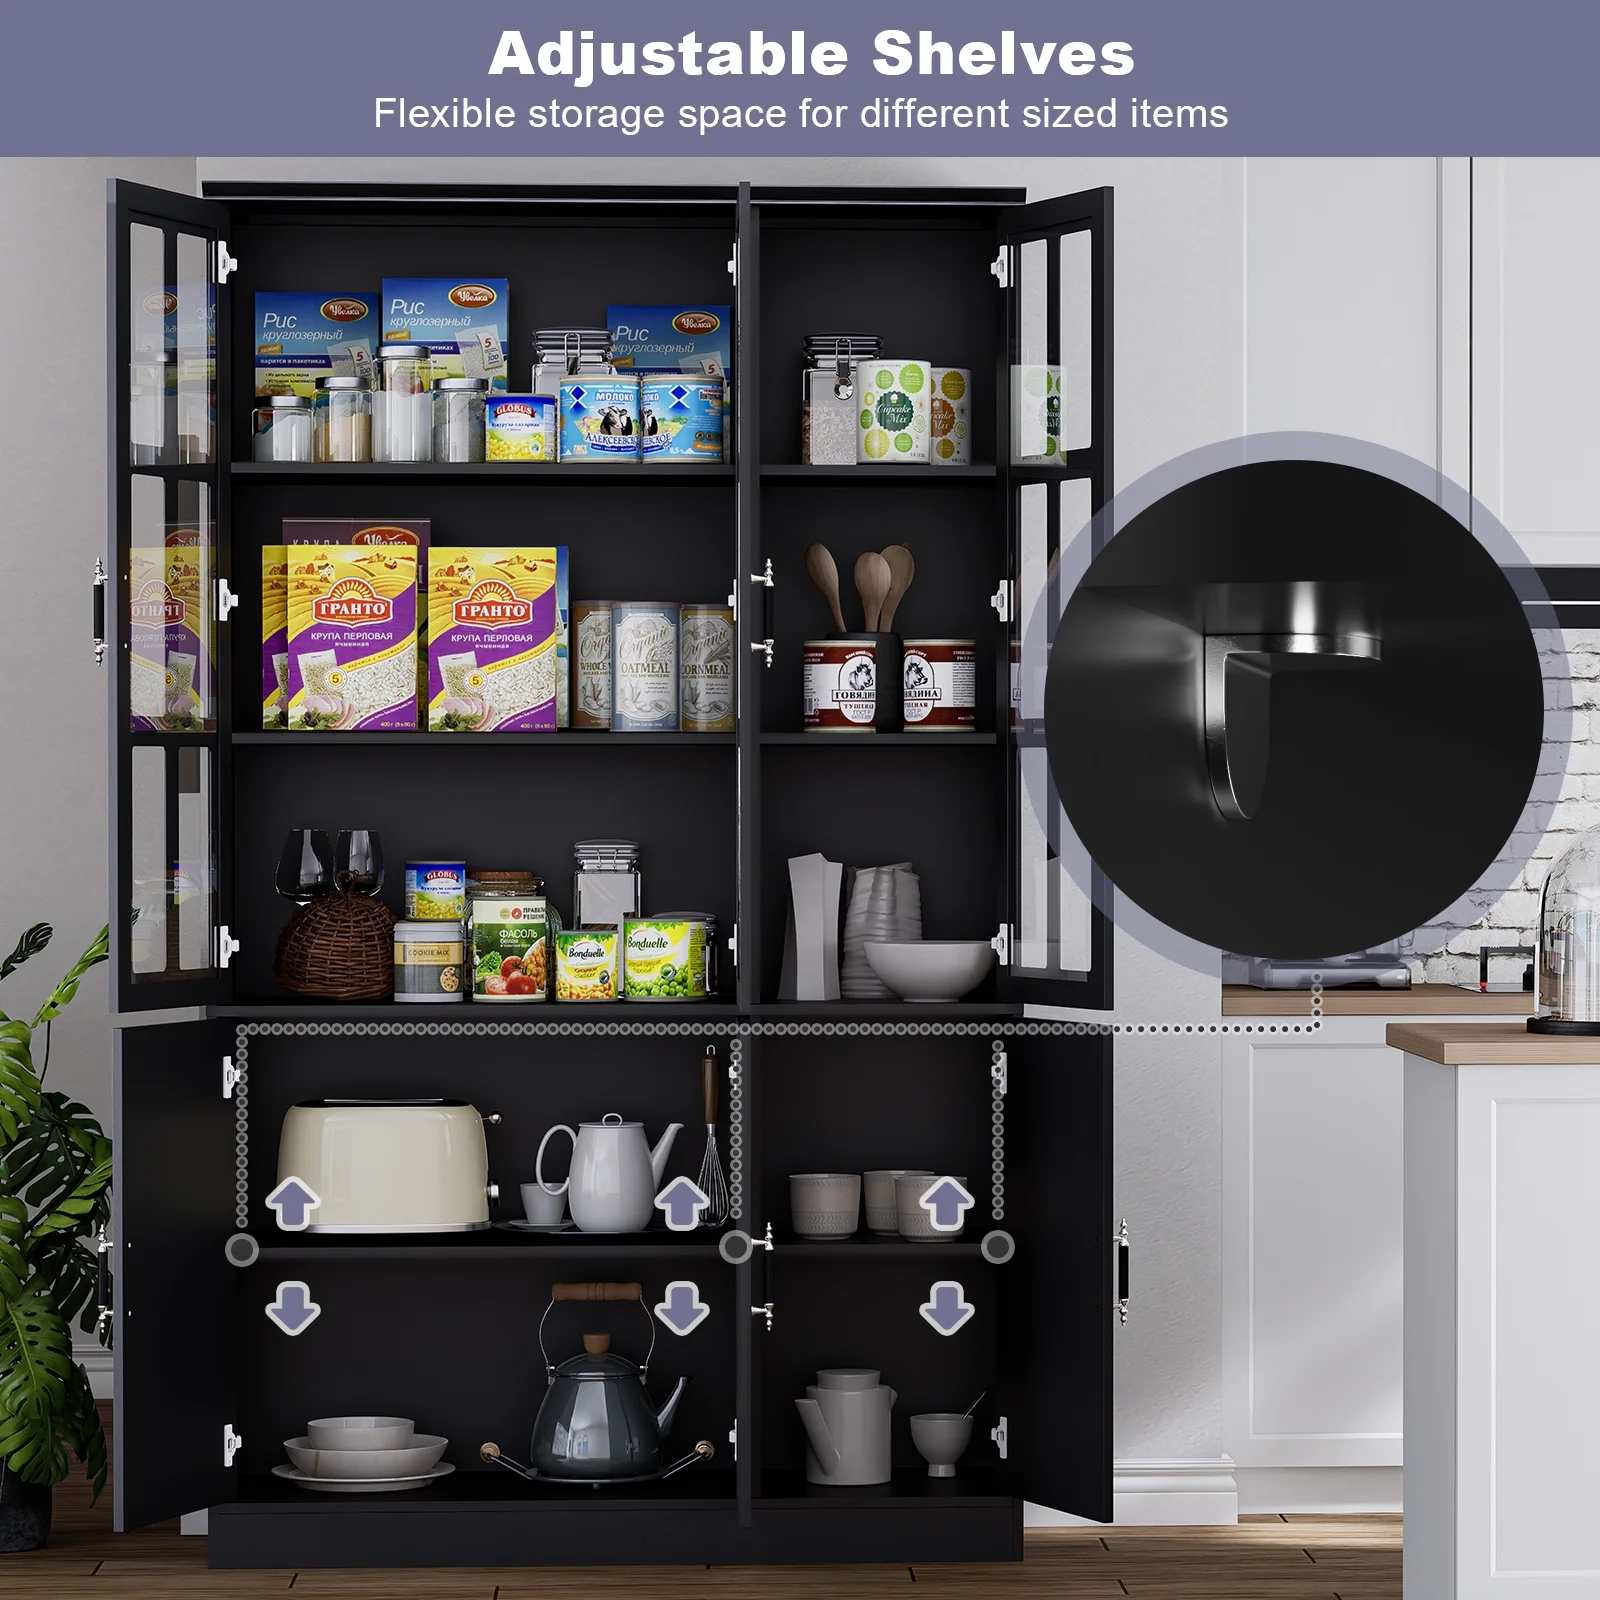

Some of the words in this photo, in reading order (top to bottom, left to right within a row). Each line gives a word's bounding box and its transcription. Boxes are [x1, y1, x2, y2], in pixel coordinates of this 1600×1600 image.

[457, 290, 489, 303] Увелка
[329, 304, 360, 316] Увелка
[390, 298, 425, 315] Рис
[263, 312, 298, 329] Рис
[390, 315, 471, 329] круглозерный
[681, 317, 712, 329] Увелка
[263, 329, 344, 342] круглозерный
[616, 325, 649, 341] Рис
[484, 337, 492, 348] 5
[356, 351, 364, 361] 5
[707, 364, 716, 375] 5
[596, 392, 634, 402] МОЛОКО
[496, 404, 532, 415] GLOBUS
[876, 404, 912, 416] Cupcake
[888, 413, 908, 424] Mix
[321, 603, 386, 615] ГРАНТО
[461, 605, 526, 617] ГРАНТО
[311, 632, 341, 641] КРУПА
[343, 632, 393, 640] ПЕРЛОВАЯ
[451, 634, 481, 642] КРУПА
[484, 634, 533, 642] ПЕРЛОВАЯ
[619, 625, 669, 661] Organic
[580, 662, 607, 671] WHOLE
[621, 662, 671, 674] OATMEAL
[332, 674, 340, 684] 5
[472, 676, 480, 686] 5
[426, 870, 458, 880] GLOBUS
[499, 928, 538, 939] ФАСОЛЬ
[627, 936, 669, 951] Bonduelle
[568, 947, 605, 961] Bonduelle
